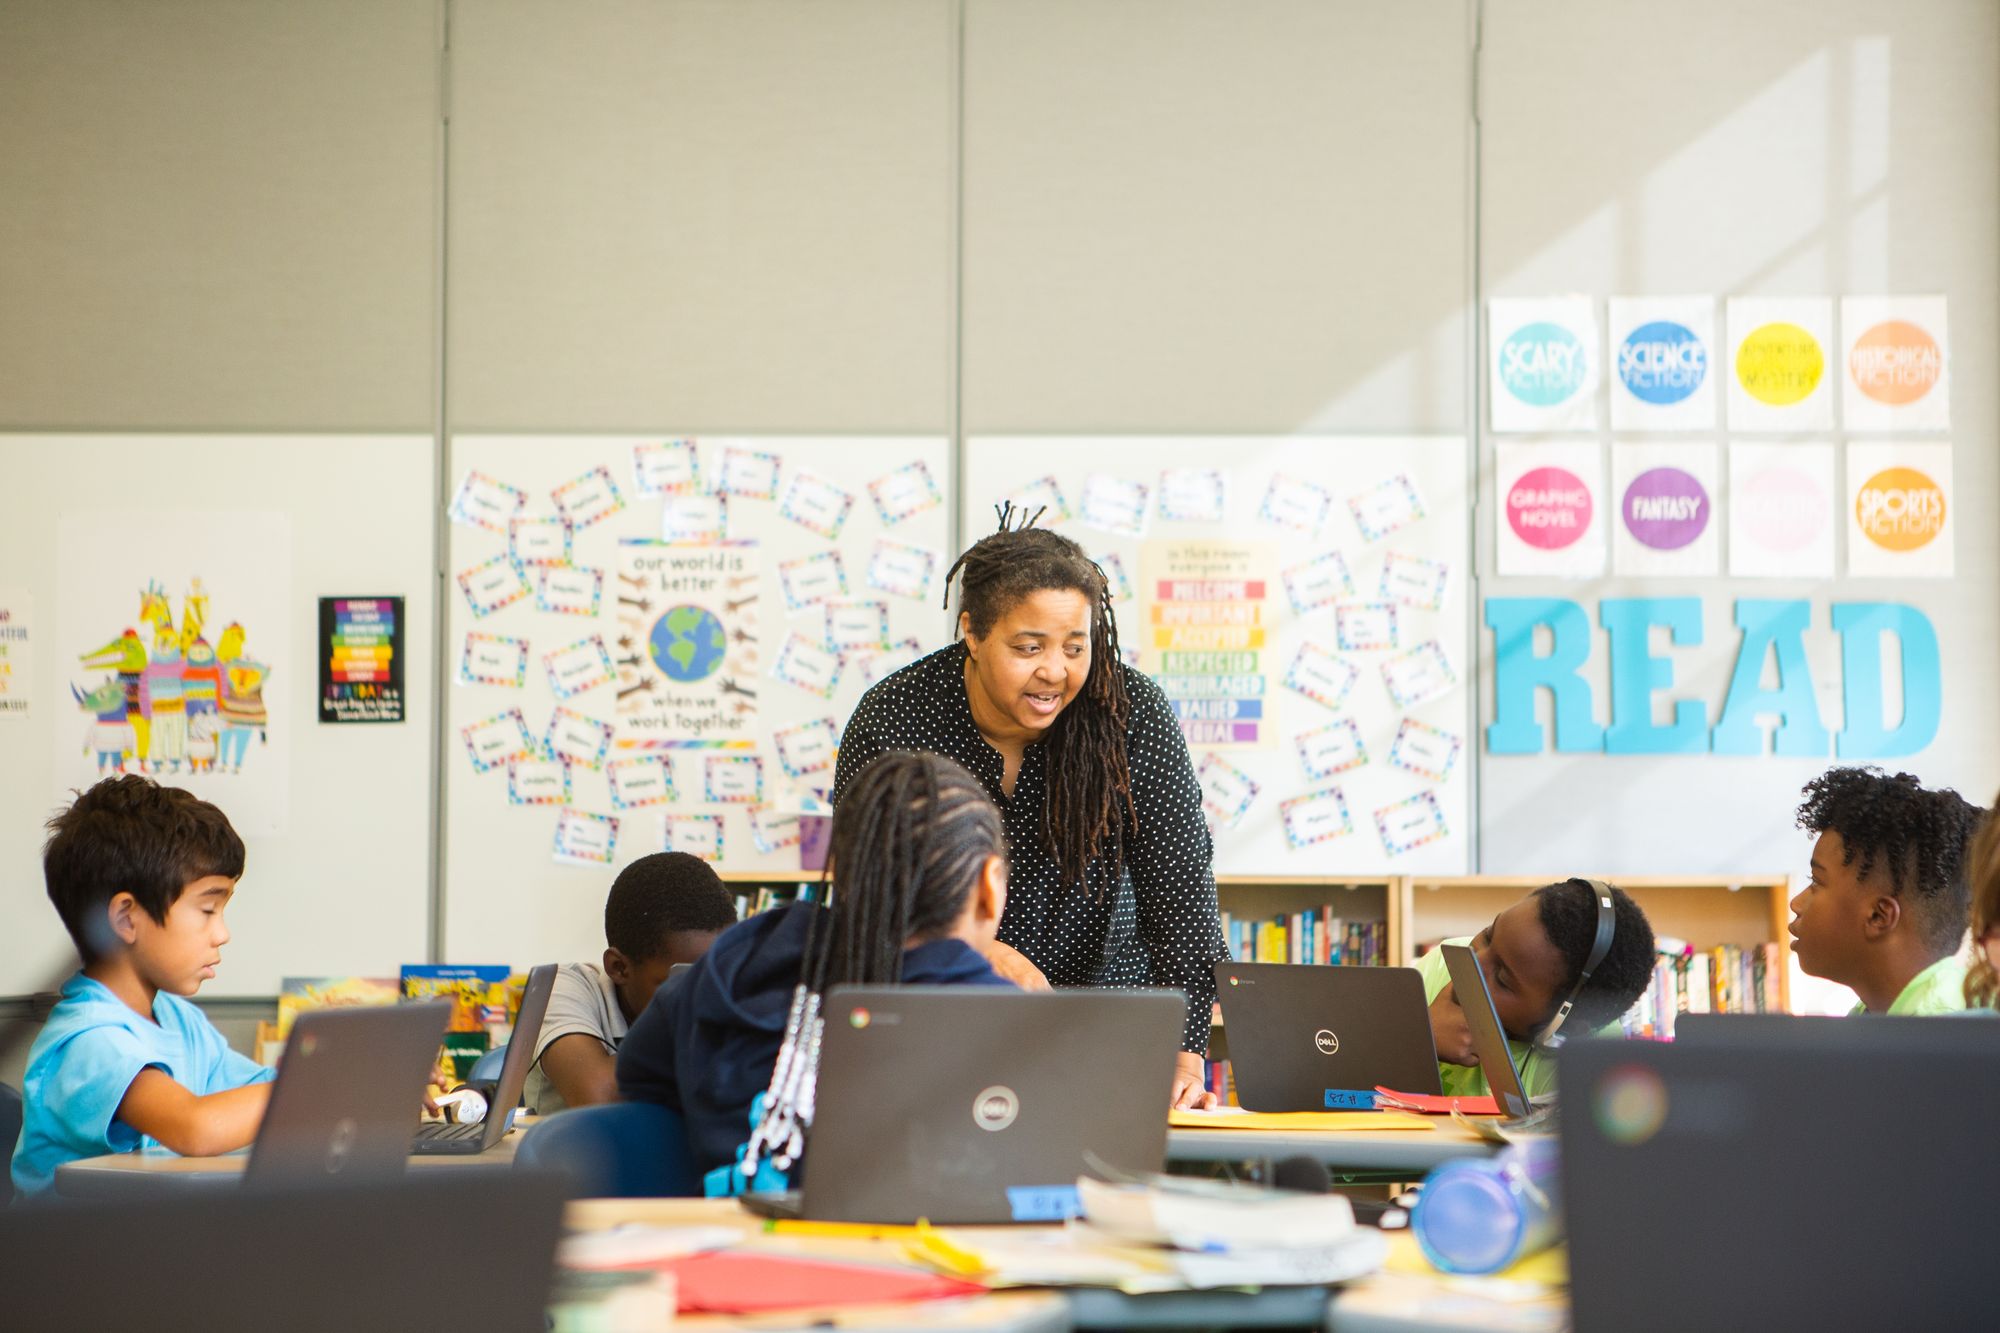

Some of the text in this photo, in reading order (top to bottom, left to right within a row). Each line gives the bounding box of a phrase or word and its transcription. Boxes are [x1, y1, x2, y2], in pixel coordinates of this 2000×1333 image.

[1503, 341, 1577, 373] SCARY
[1621, 341, 1705, 371] SCIENCE
[1851, 346, 1942, 369] HISTORICAL
[1506, 369, 1583, 388] FICTION
[1624, 369, 1703, 388] FICTION
[1857, 367, 1935, 385] FICTION
[1511, 489, 1588, 508] GRAPHIC
[1633, 496, 1701, 521] FANTASY
[1860, 488, 1941, 517] SPORTS
[1520, 509, 1576, 528] NOVEL
[1862, 515, 1941, 534] FICTION
[634, 554, 743, 570] our world is
[661, 574, 716, 591] better
[1173, 581, 1245, 600] WELCOME
[1162, 604, 1254, 624] IMPORTANT
[1171, 628, 1249, 648] ACCEPTED
[1167, 653, 1253, 673] RESPECTED
[1484, 597, 1942, 758] READ
[652, 692, 717, 707] when we
[1180, 699, 1238, 719] VALUED
[629, 712, 745, 736] work together
[1184, 722, 1233, 743] EQUAL
[1318, 1038, 1337, 1046] DELL
